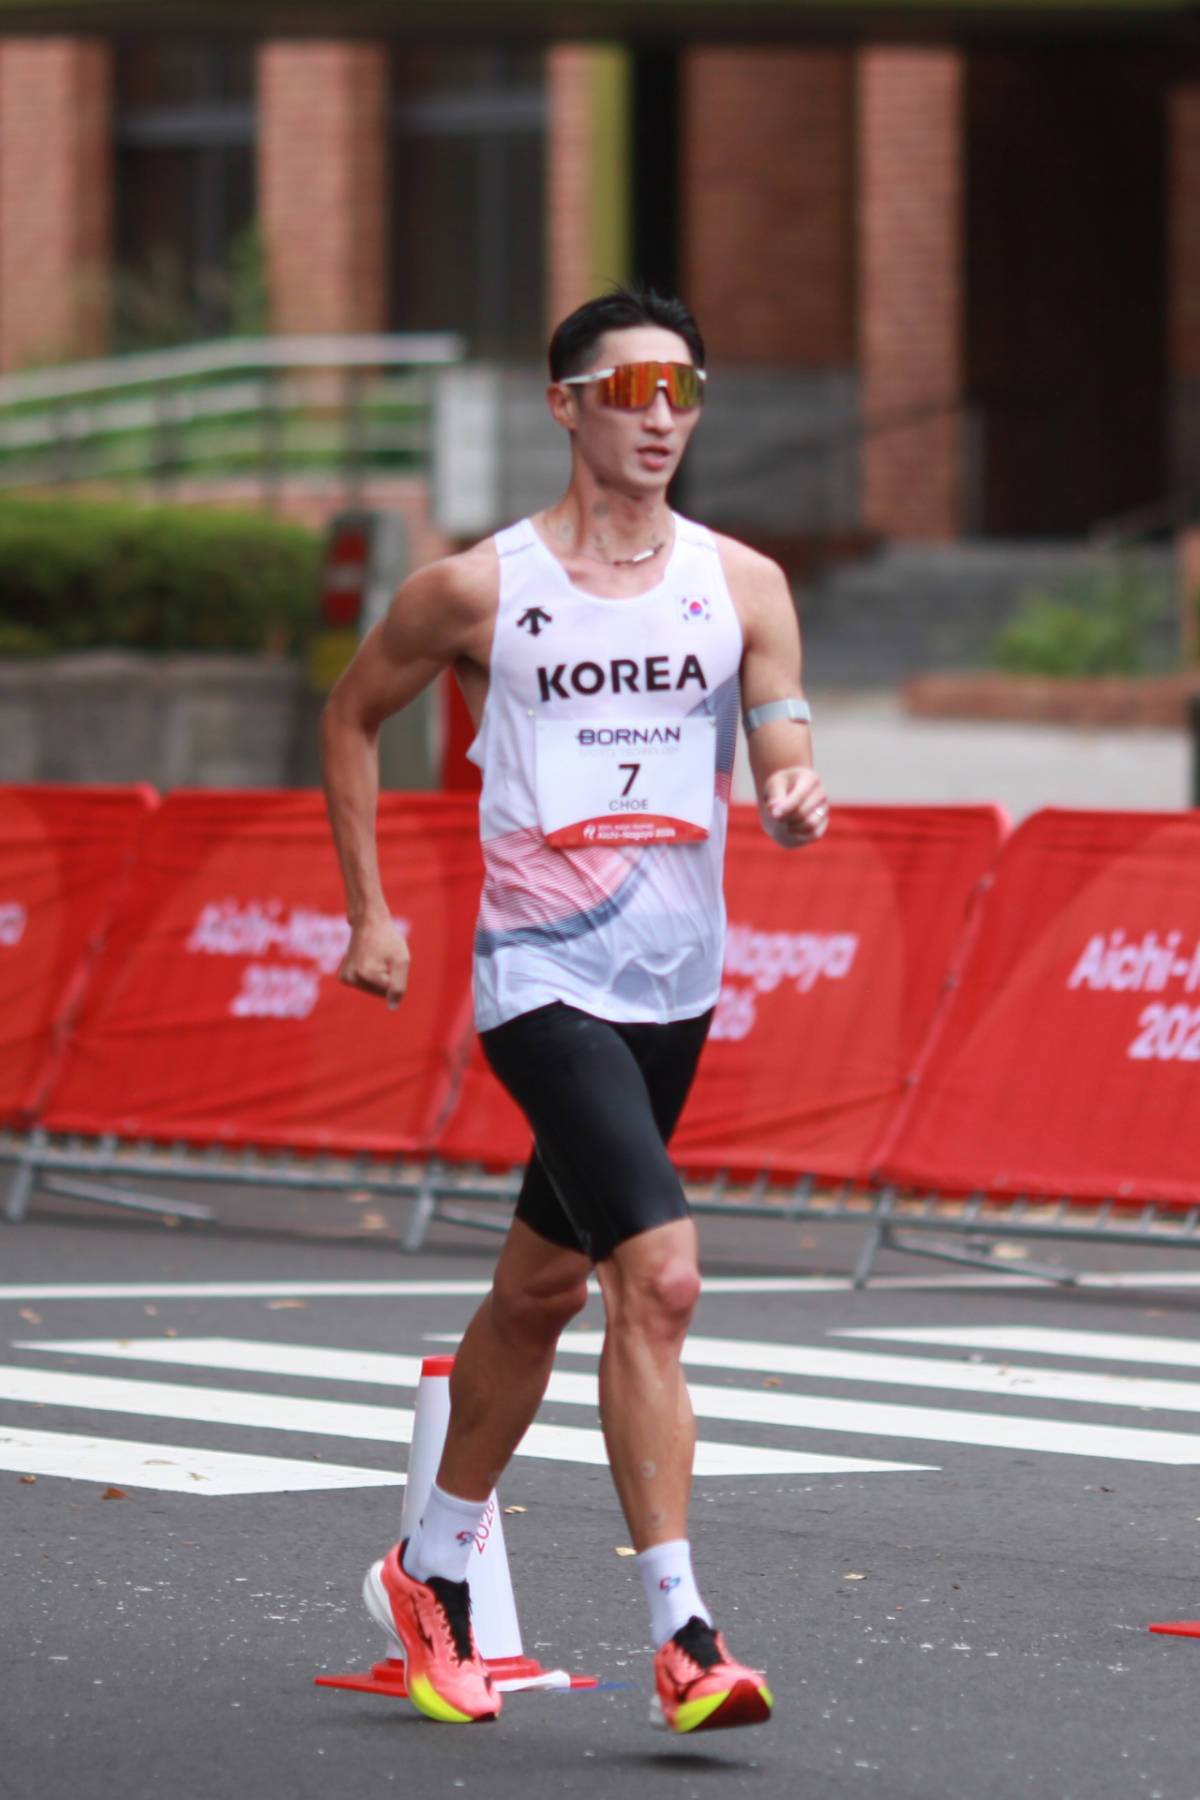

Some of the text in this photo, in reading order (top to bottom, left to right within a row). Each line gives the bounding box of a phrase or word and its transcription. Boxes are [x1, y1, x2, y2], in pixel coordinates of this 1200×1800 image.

[537, 654, 708, 702] KOREA
[577, 726, 681, 746] BORNAN
[618, 763, 641, 797] 7
[608, 799, 649, 811] CHOE
[724, 922, 860, 993] Nagoya
[1127, 1000, 1200, 1061] 202
